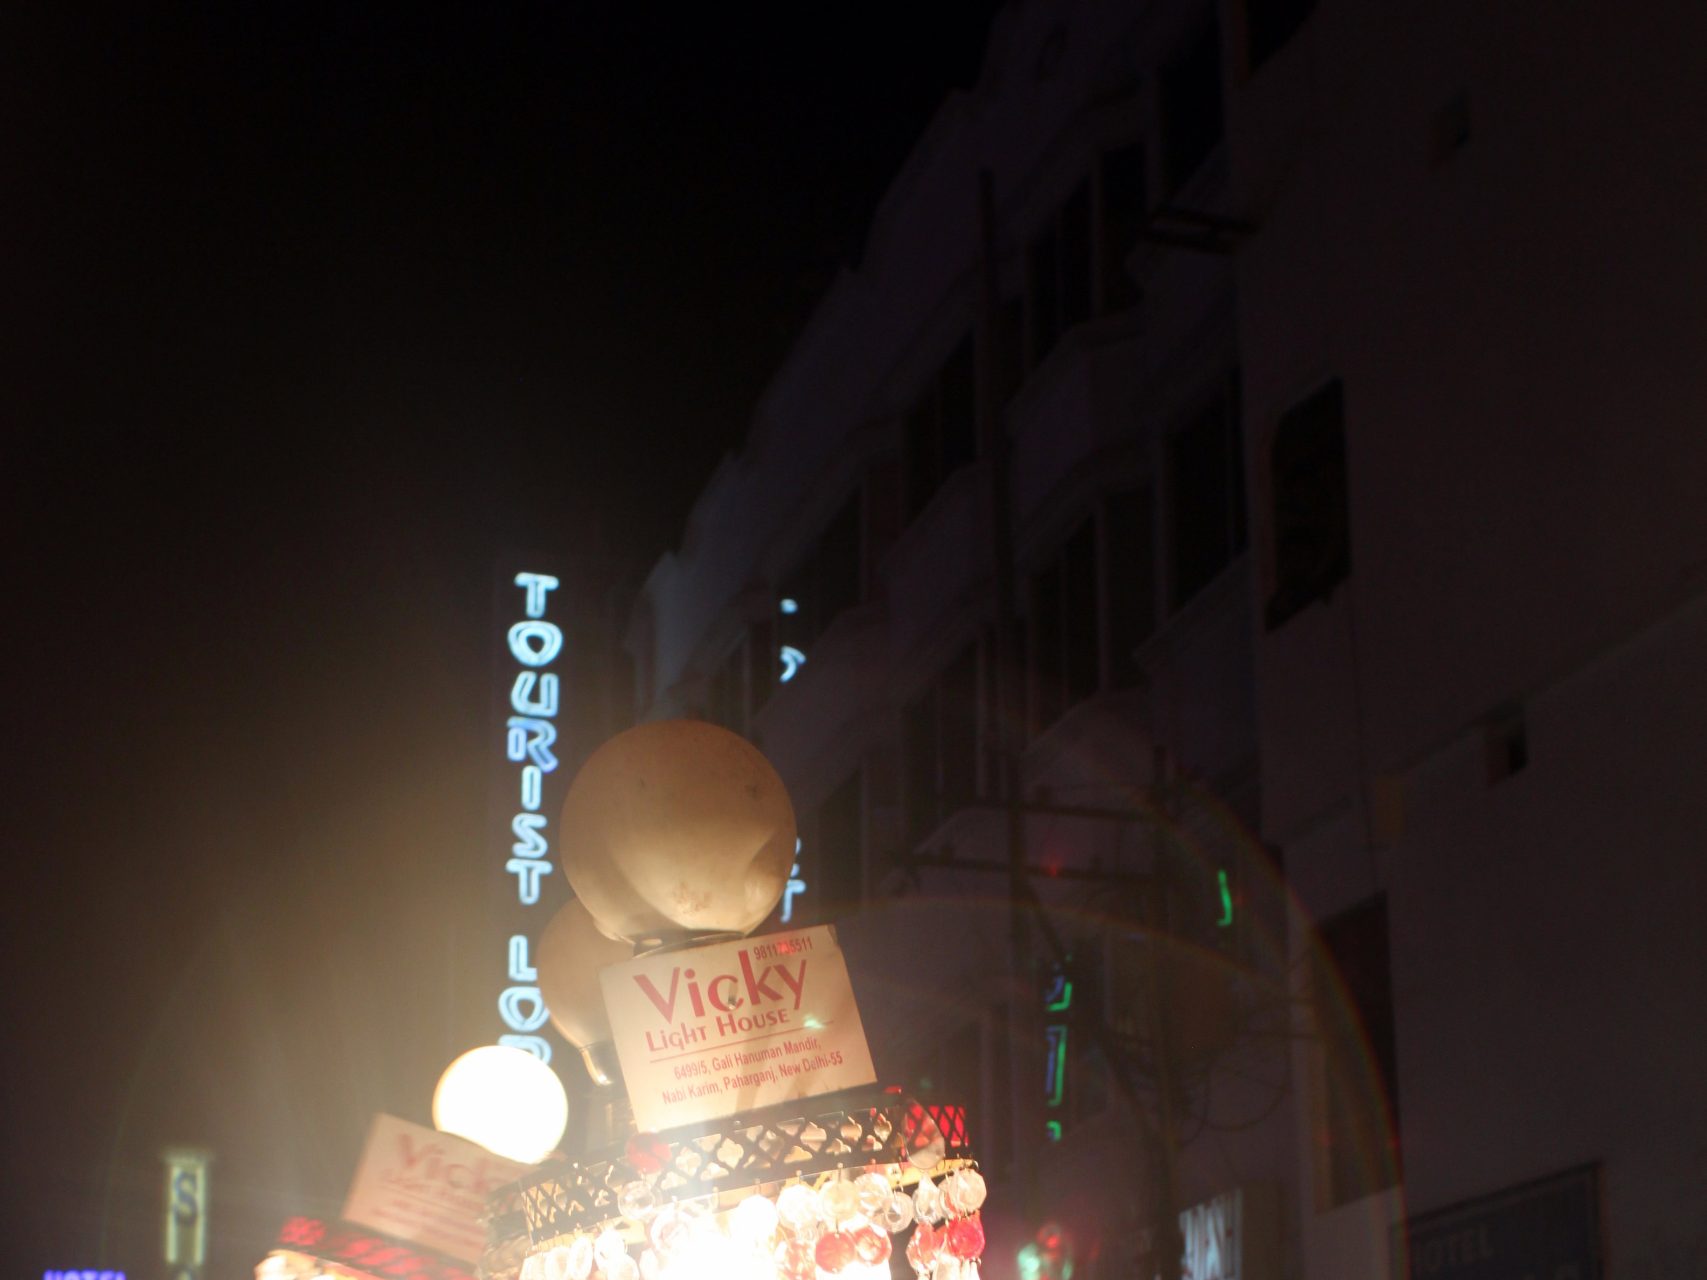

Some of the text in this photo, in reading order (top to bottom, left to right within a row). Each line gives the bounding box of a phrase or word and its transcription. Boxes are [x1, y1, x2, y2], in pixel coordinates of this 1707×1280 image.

[506, 571, 563, 905] TOURIST
[633, 949, 808, 1025] Vicky
[662, 1050, 844, 1105] Nabi Karim, Paharganj, New Delhi-55
[673, 1036, 822, 1081] 6499/5, Gali Hanuman Mandir,
